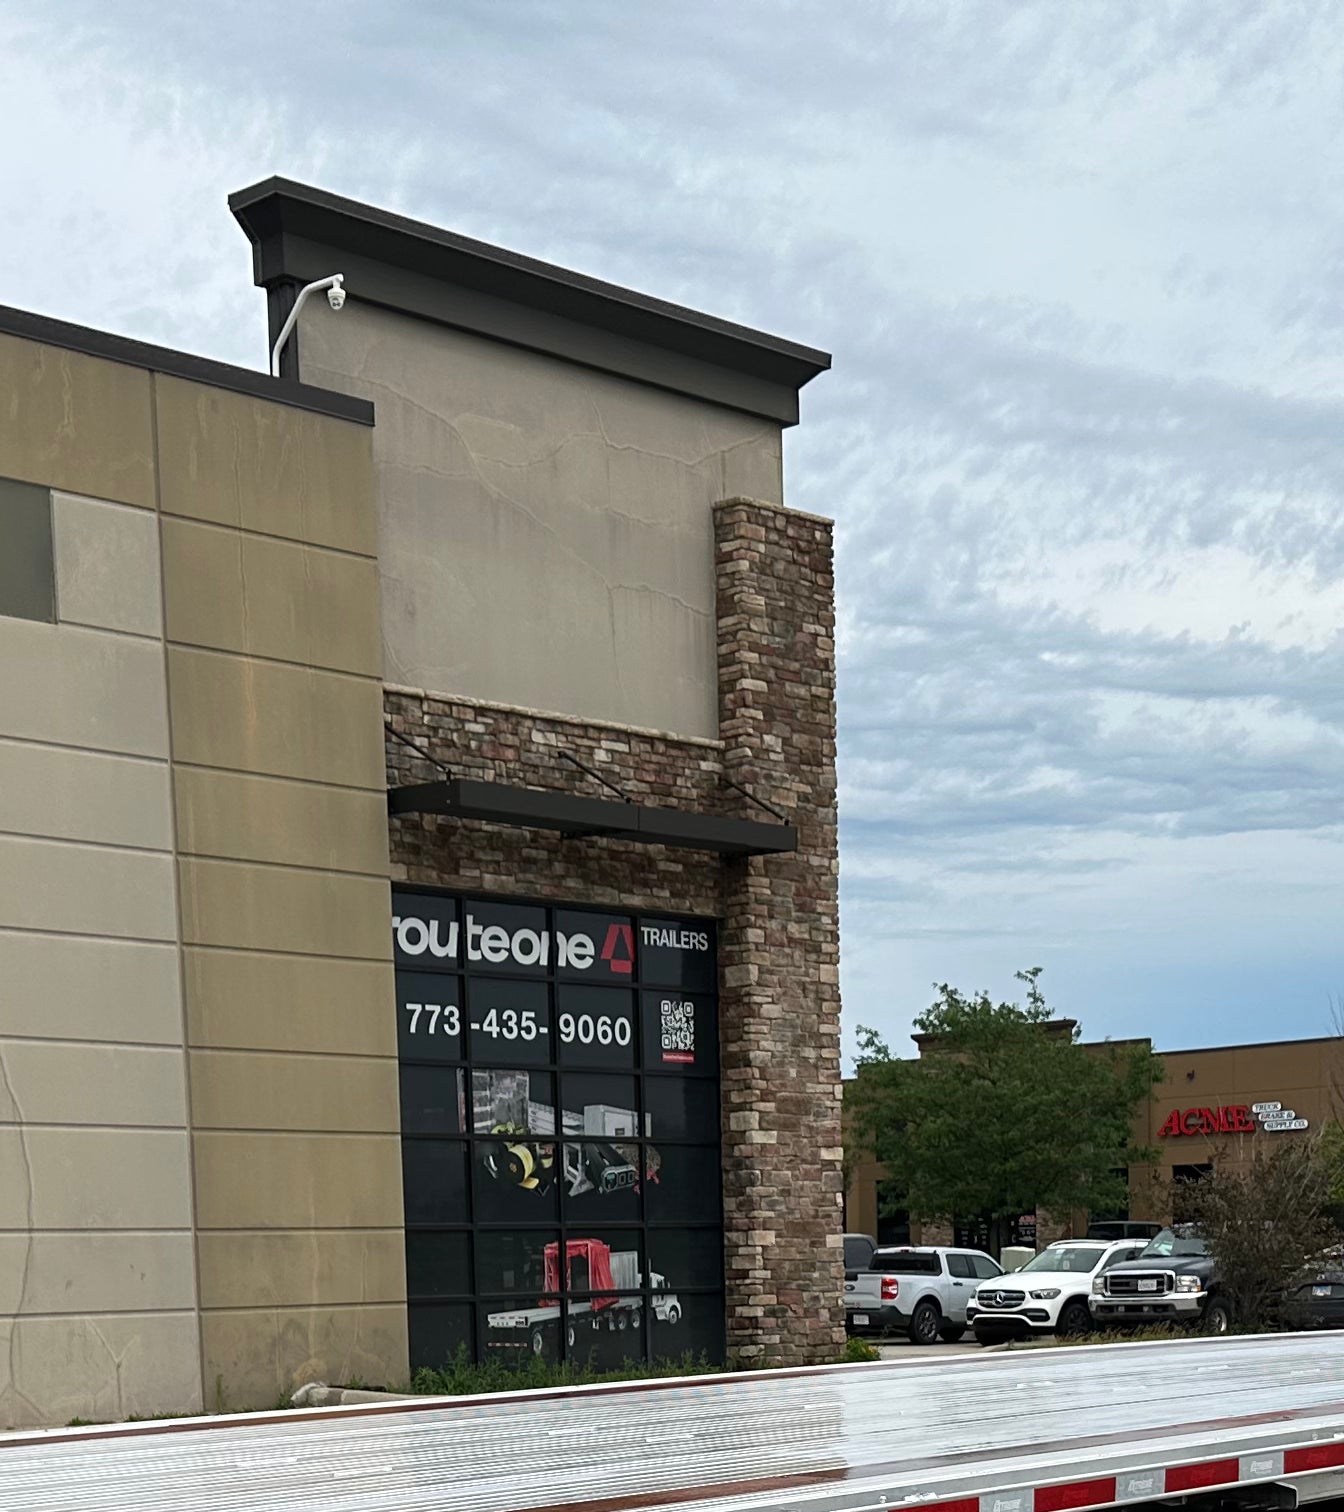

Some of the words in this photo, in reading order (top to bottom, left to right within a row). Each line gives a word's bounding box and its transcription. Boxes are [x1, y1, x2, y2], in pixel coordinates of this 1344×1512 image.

[392, 914, 596, 970] outeone
[641, 926, 709, 951] TRAILERS
[1157, 1105, 1254, 1136] ACME
